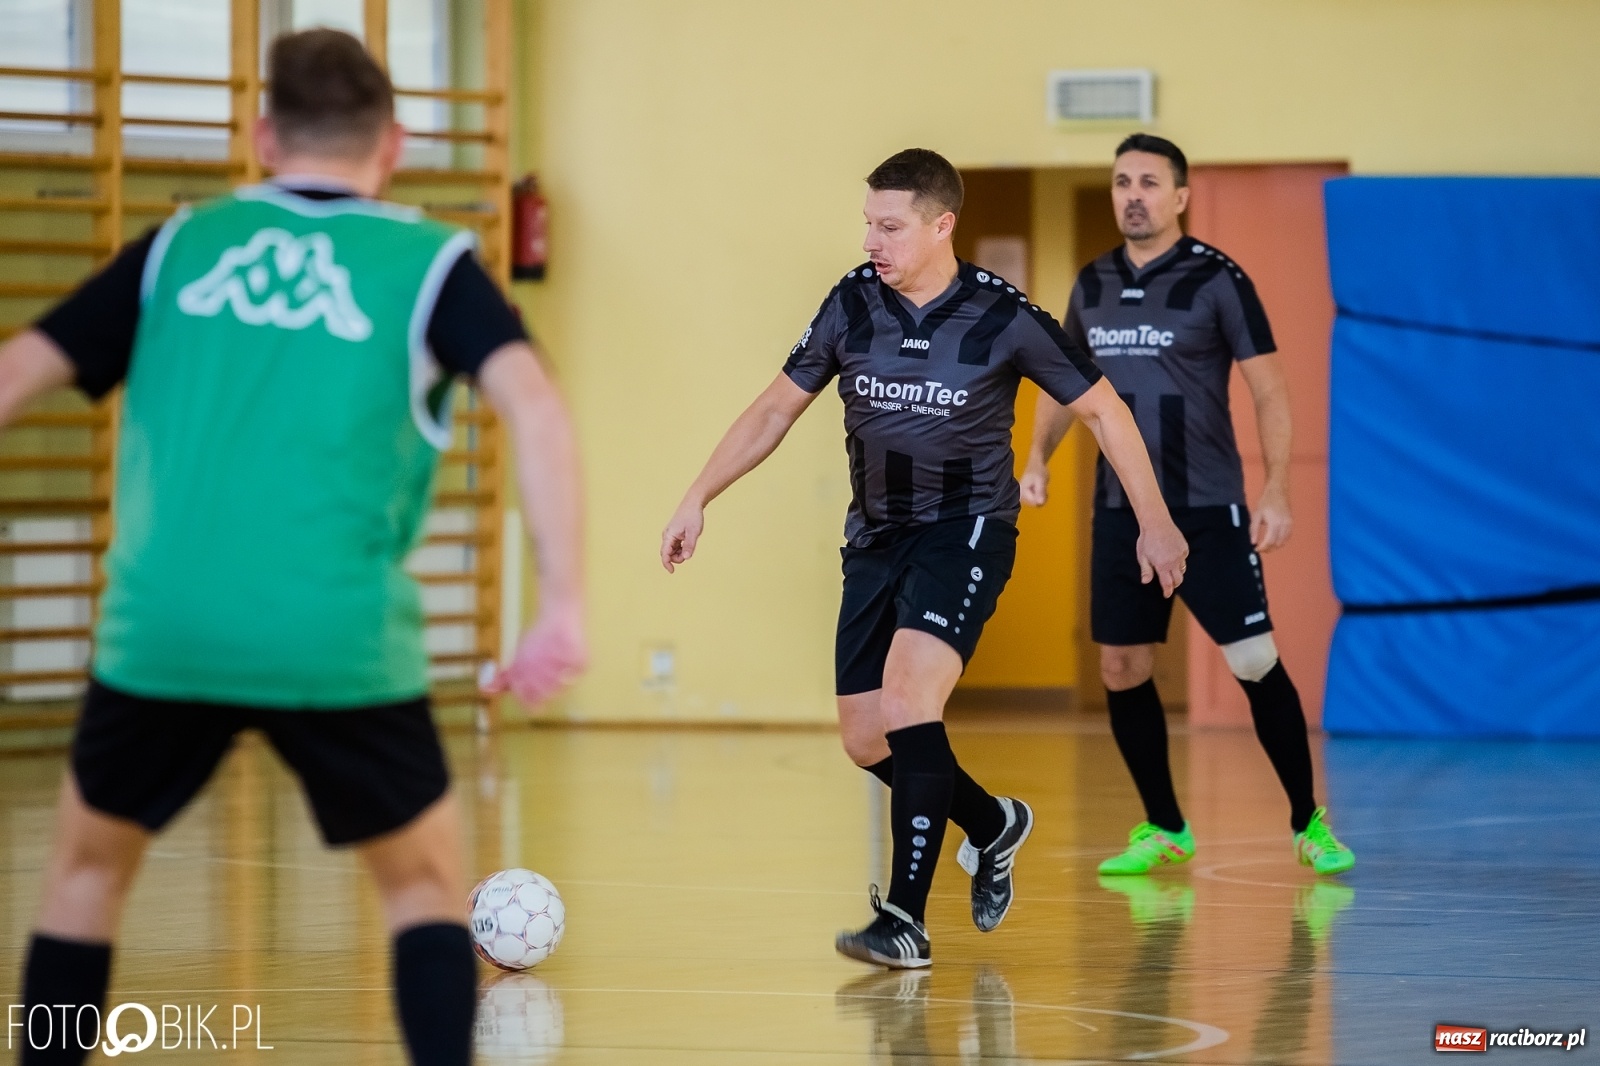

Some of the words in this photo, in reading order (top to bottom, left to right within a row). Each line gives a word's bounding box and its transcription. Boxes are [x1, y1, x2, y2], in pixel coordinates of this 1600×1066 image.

[901, 338, 930, 351] JAKO
[1087, 325, 1174, 347] ChomTec
[855, 374, 969, 407] ChomTec
[869, 399, 902, 412] WASSER
[911, 404, 951, 417] ENERGIE
[923, 610, 948, 628] JAKO
